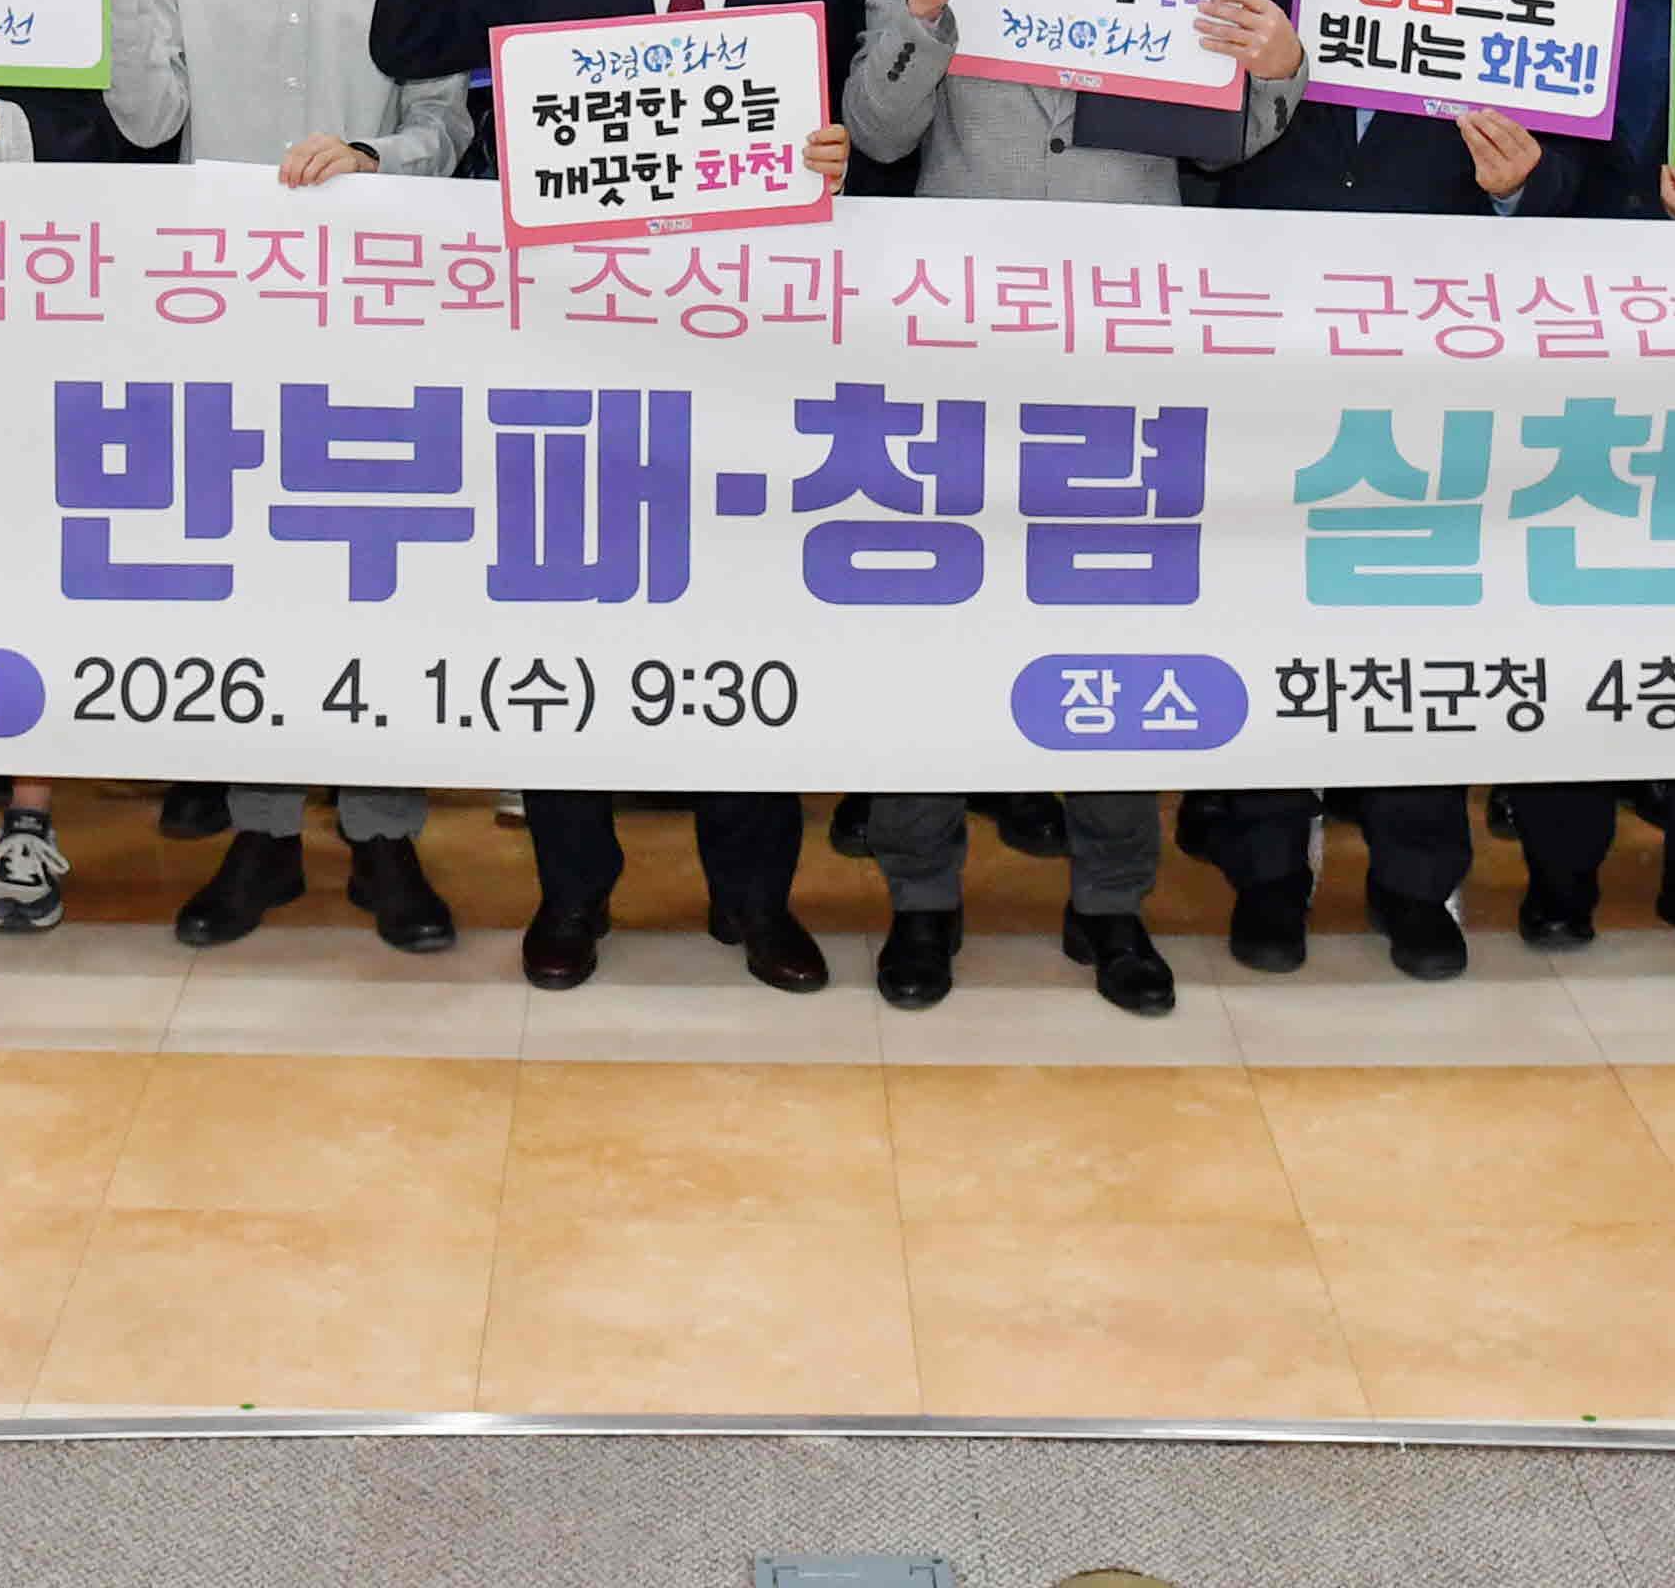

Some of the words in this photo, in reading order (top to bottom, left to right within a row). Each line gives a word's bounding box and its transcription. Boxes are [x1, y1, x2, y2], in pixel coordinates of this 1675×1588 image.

[1319, 13, 1466, 80] 빛나는
[1478, 32, 1598, 95] 화천!
[533, 88, 687, 146] 청렴한
[701, 80, 780, 132] 오늘
[535, 153, 682, 207] 깨끗한
[695, 143, 794, 192] 화천
[144, 225, 534, 329] 공직문화
[566, 244, 859, 344] 조성과
[892, 256, 1284, 355] 신뢰받는
[73, 658, 285, 727] 2026.
[324, 659, 389, 726] 4.
[630, 659, 798, 728] 9:30
[1275, 657, 1549, 734] 화천군청
